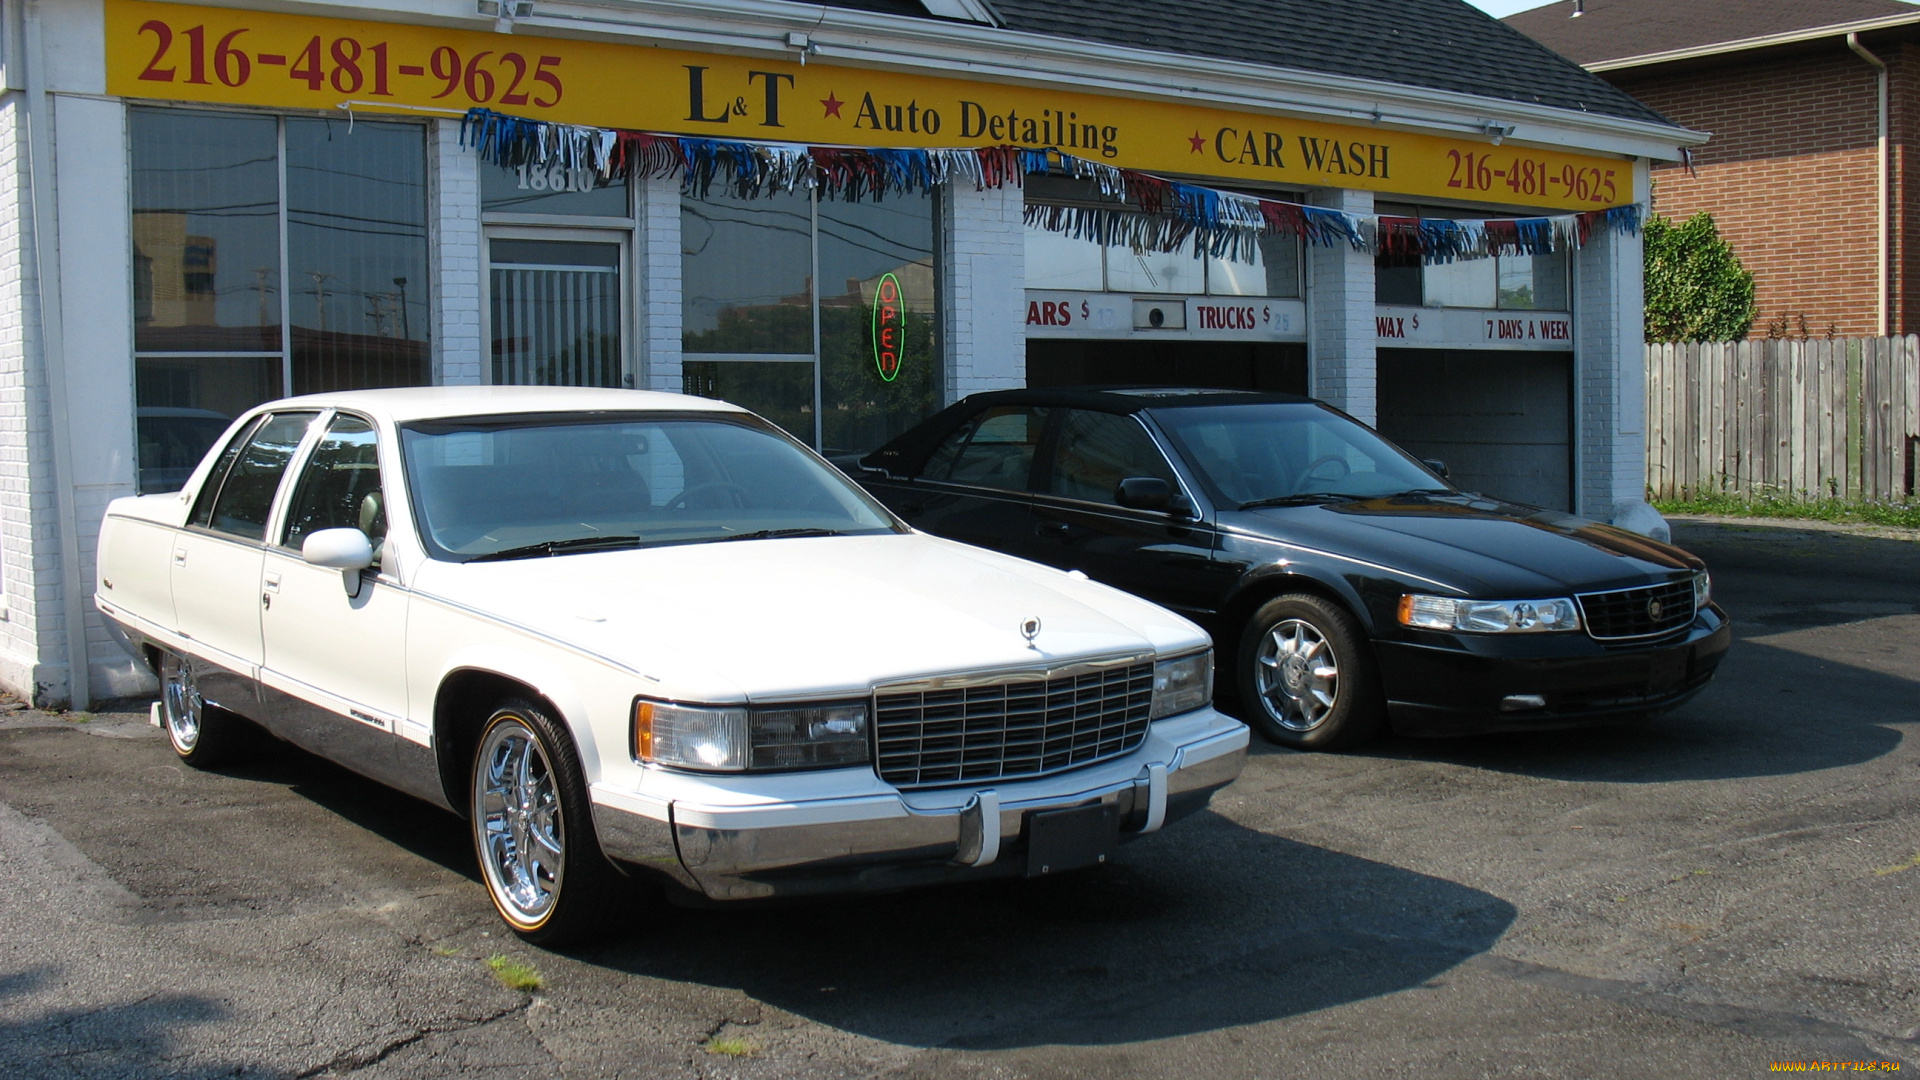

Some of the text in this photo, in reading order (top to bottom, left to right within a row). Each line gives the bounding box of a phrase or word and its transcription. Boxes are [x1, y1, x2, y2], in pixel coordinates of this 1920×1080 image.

[137, 19, 563, 108] 216-481-9625
[854, 91, 1118, 158] Auto Detailing
[1214, 127, 1390, 179] CAR WASH
[516, 163, 595, 193] 18610
[1446, 148, 1617, 205] 216-481-9625
[881, 281, 897, 371] OPEN
[1081, 299, 1090, 321] $
[1197, 306, 1256, 329] TRUCKS
[1263, 305, 1271, 324] $
[1376, 313, 1419, 339] WAX $
[1486, 319, 1569, 340] 7 DAYS A WEEK
